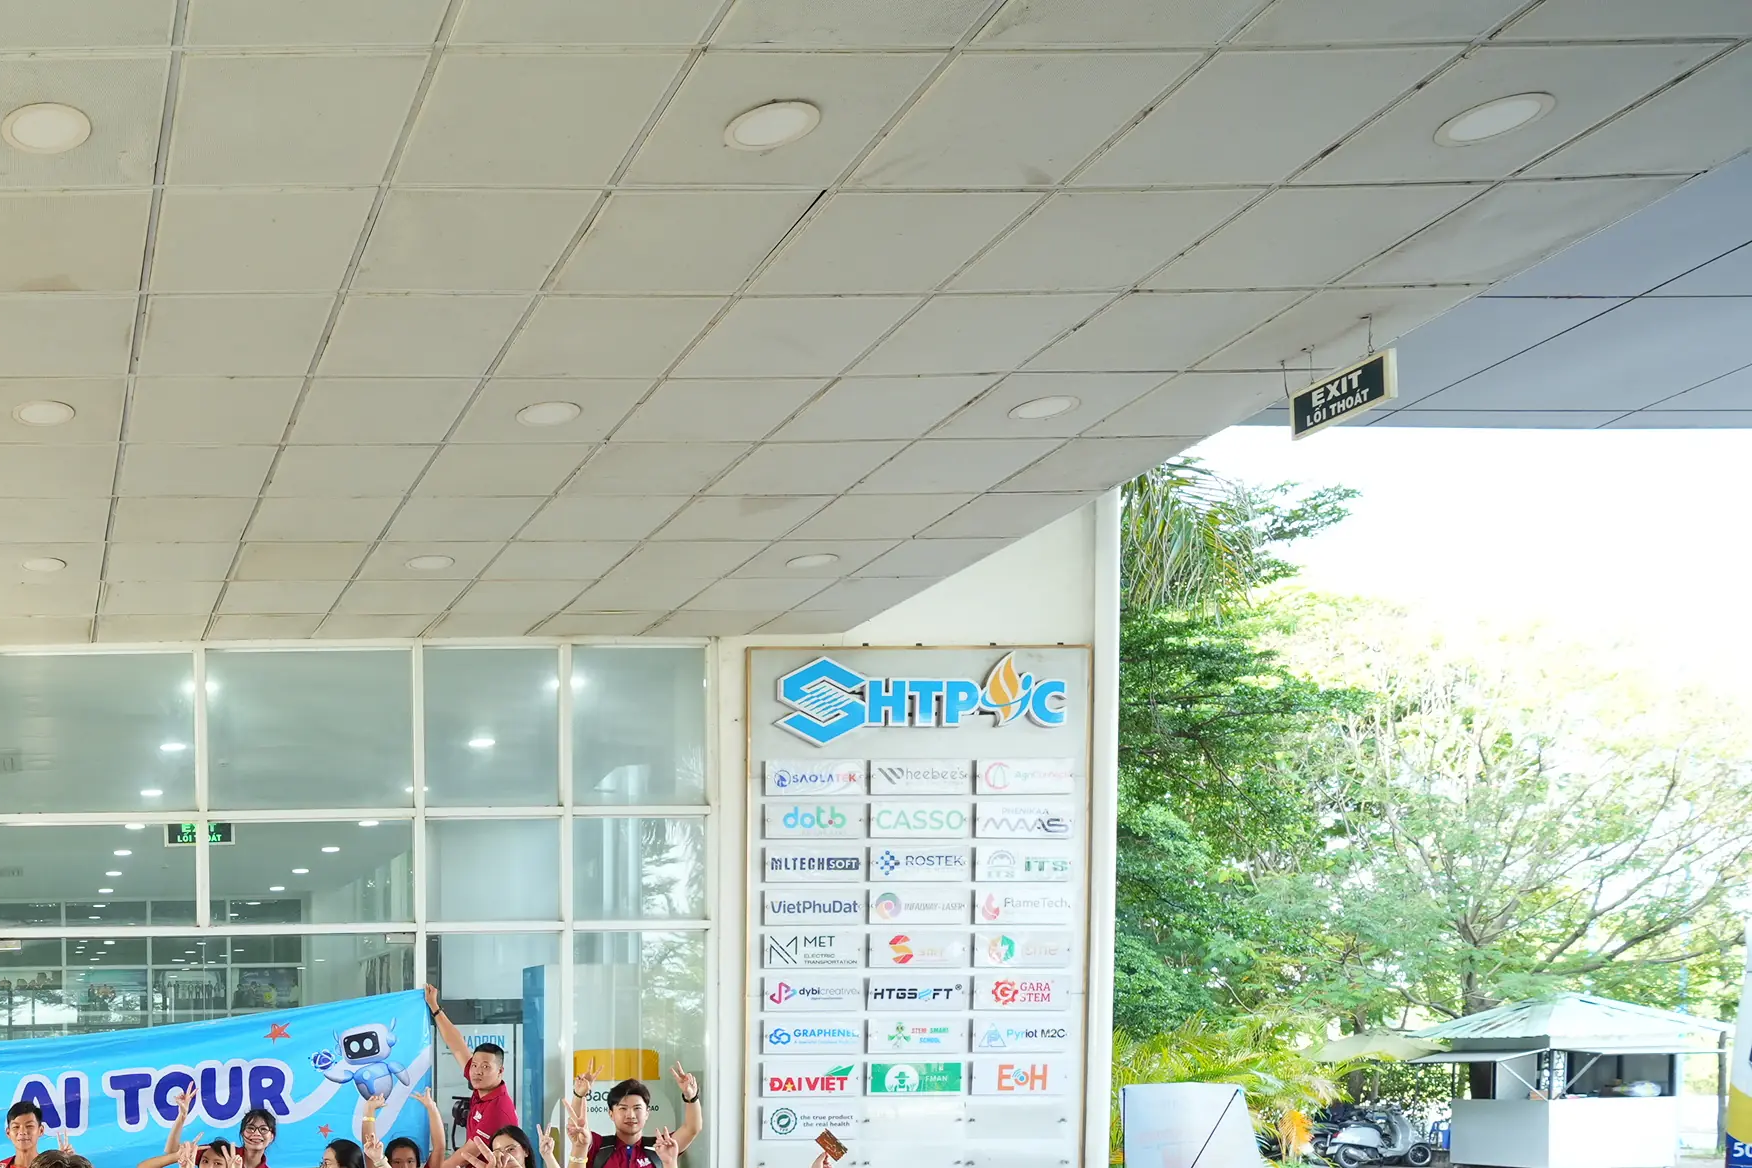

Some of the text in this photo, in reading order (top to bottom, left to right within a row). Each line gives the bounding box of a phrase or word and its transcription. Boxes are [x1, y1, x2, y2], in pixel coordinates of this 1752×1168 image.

[1311, 369, 1363, 407] EXIT
[1306, 387, 1370, 427] LỐI THOÁT
[792, 773, 857, 784] SAOLATEK
[875, 809, 965, 831] CASSO
[906, 854, 964, 867] ROSTEK
[770, 900, 858, 914] VietPhuDat
[803, 935, 835, 948] MET
[1019, 982, 1051, 992] GARA
[1019, 993, 1051, 1003] STEM
[1006, 1028, 1065, 1041] Pyriot M2C
[12, 1083, 82, 1131] AI
[108, 1064, 291, 1124] TOUR
[828, 1114, 853, 1122] product
